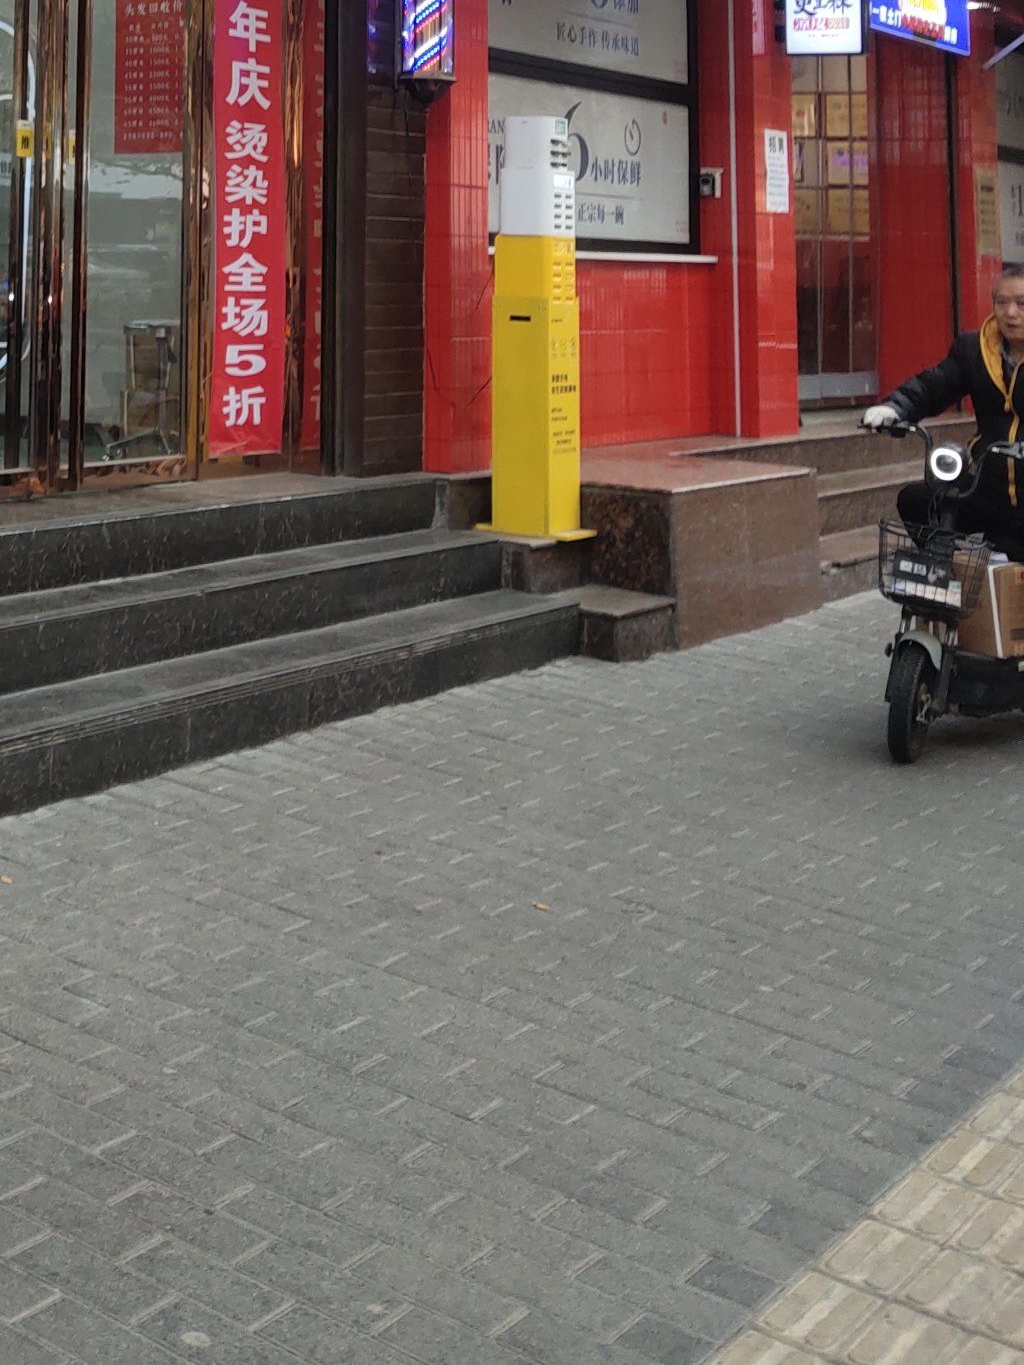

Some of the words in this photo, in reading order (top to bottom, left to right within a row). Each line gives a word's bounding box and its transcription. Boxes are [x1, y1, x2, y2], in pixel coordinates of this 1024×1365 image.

[221, 119, 269, 428] 烫染护全场5折
